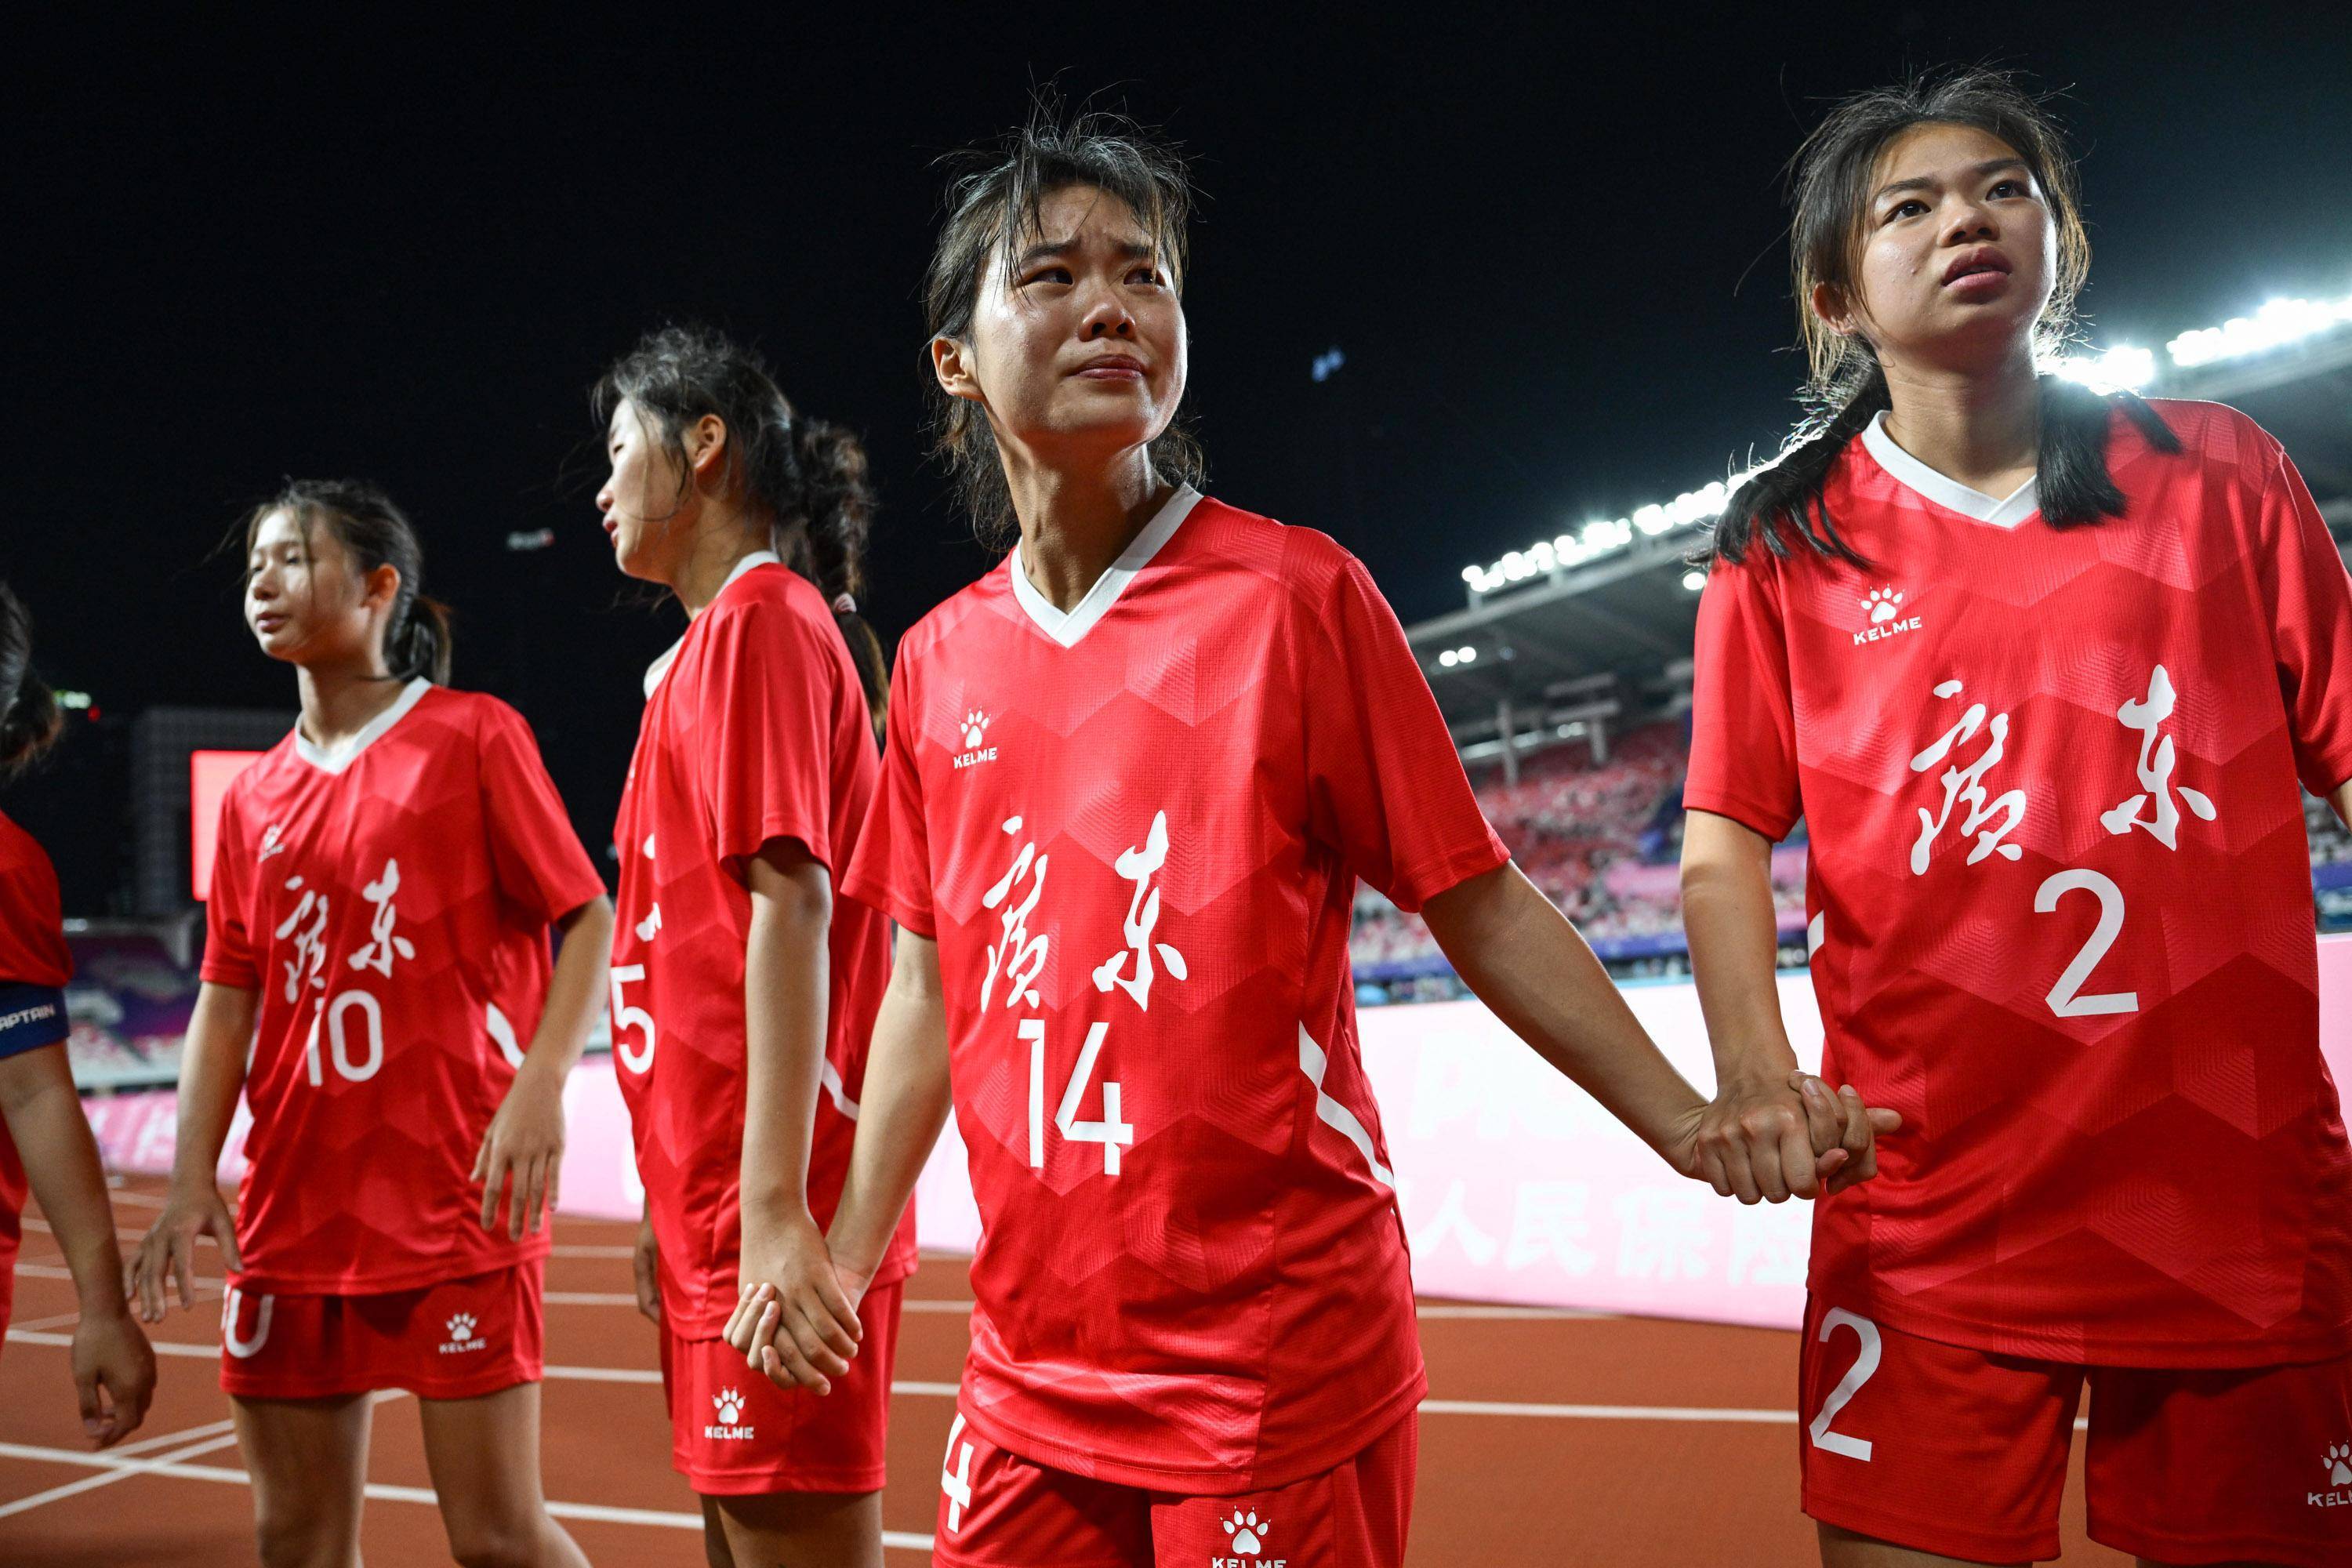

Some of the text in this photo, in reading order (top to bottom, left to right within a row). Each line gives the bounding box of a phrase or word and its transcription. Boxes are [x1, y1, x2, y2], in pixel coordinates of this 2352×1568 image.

[1853, 616, 1922, 646] KELME
[953, 746, 998, 769] KELME
[2034, 869, 2139, 1017] 2
[307, 989, 383, 1087] 10
[610, 963, 655, 1075] 5
[1018, 1018, 1133, 1175] 14
[1396, 1174, 1813, 1289] 人民保险
[439, 1337, 487, 1355] KELME
[1809, 1307, 1882, 1463] 2
[705, 1425, 754, 1439] KELME
[941, 1412, 975, 1534] 4
